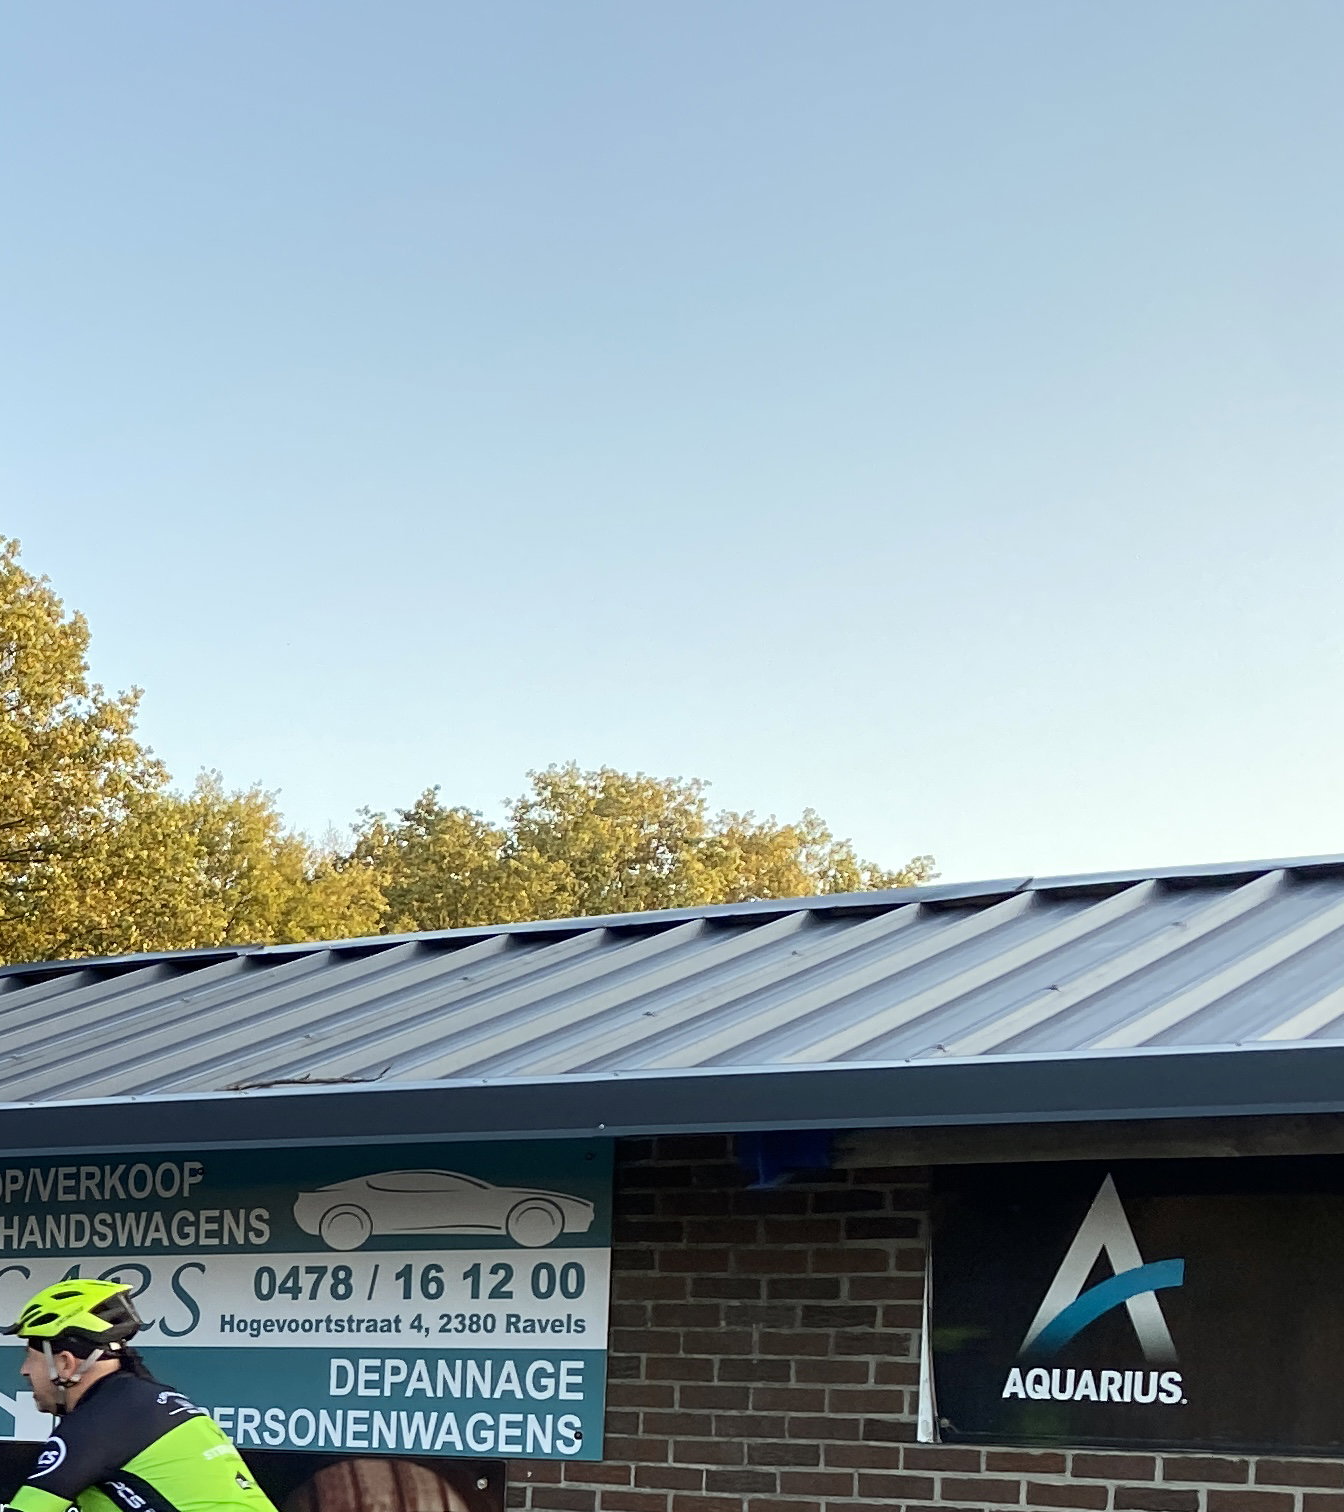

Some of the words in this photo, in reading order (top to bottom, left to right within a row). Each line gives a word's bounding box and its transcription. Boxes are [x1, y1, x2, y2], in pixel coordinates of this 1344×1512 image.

[253, 1264, 353, 1301] 0478
[366, 1263, 380, 1301] /
[395, 1262, 445, 1300] 16
[463, 1262, 513, 1300] 12
[530, 1261, 586, 1300] 00
[219, 1313, 402, 1338] Hogevoortstraat
[409, 1313, 430, 1338] 4,
[438, 1313, 497, 1334] 2380
[505, 1313, 586, 1334] Ravels
[329, 1357, 585, 1401] DEPANNAGE
